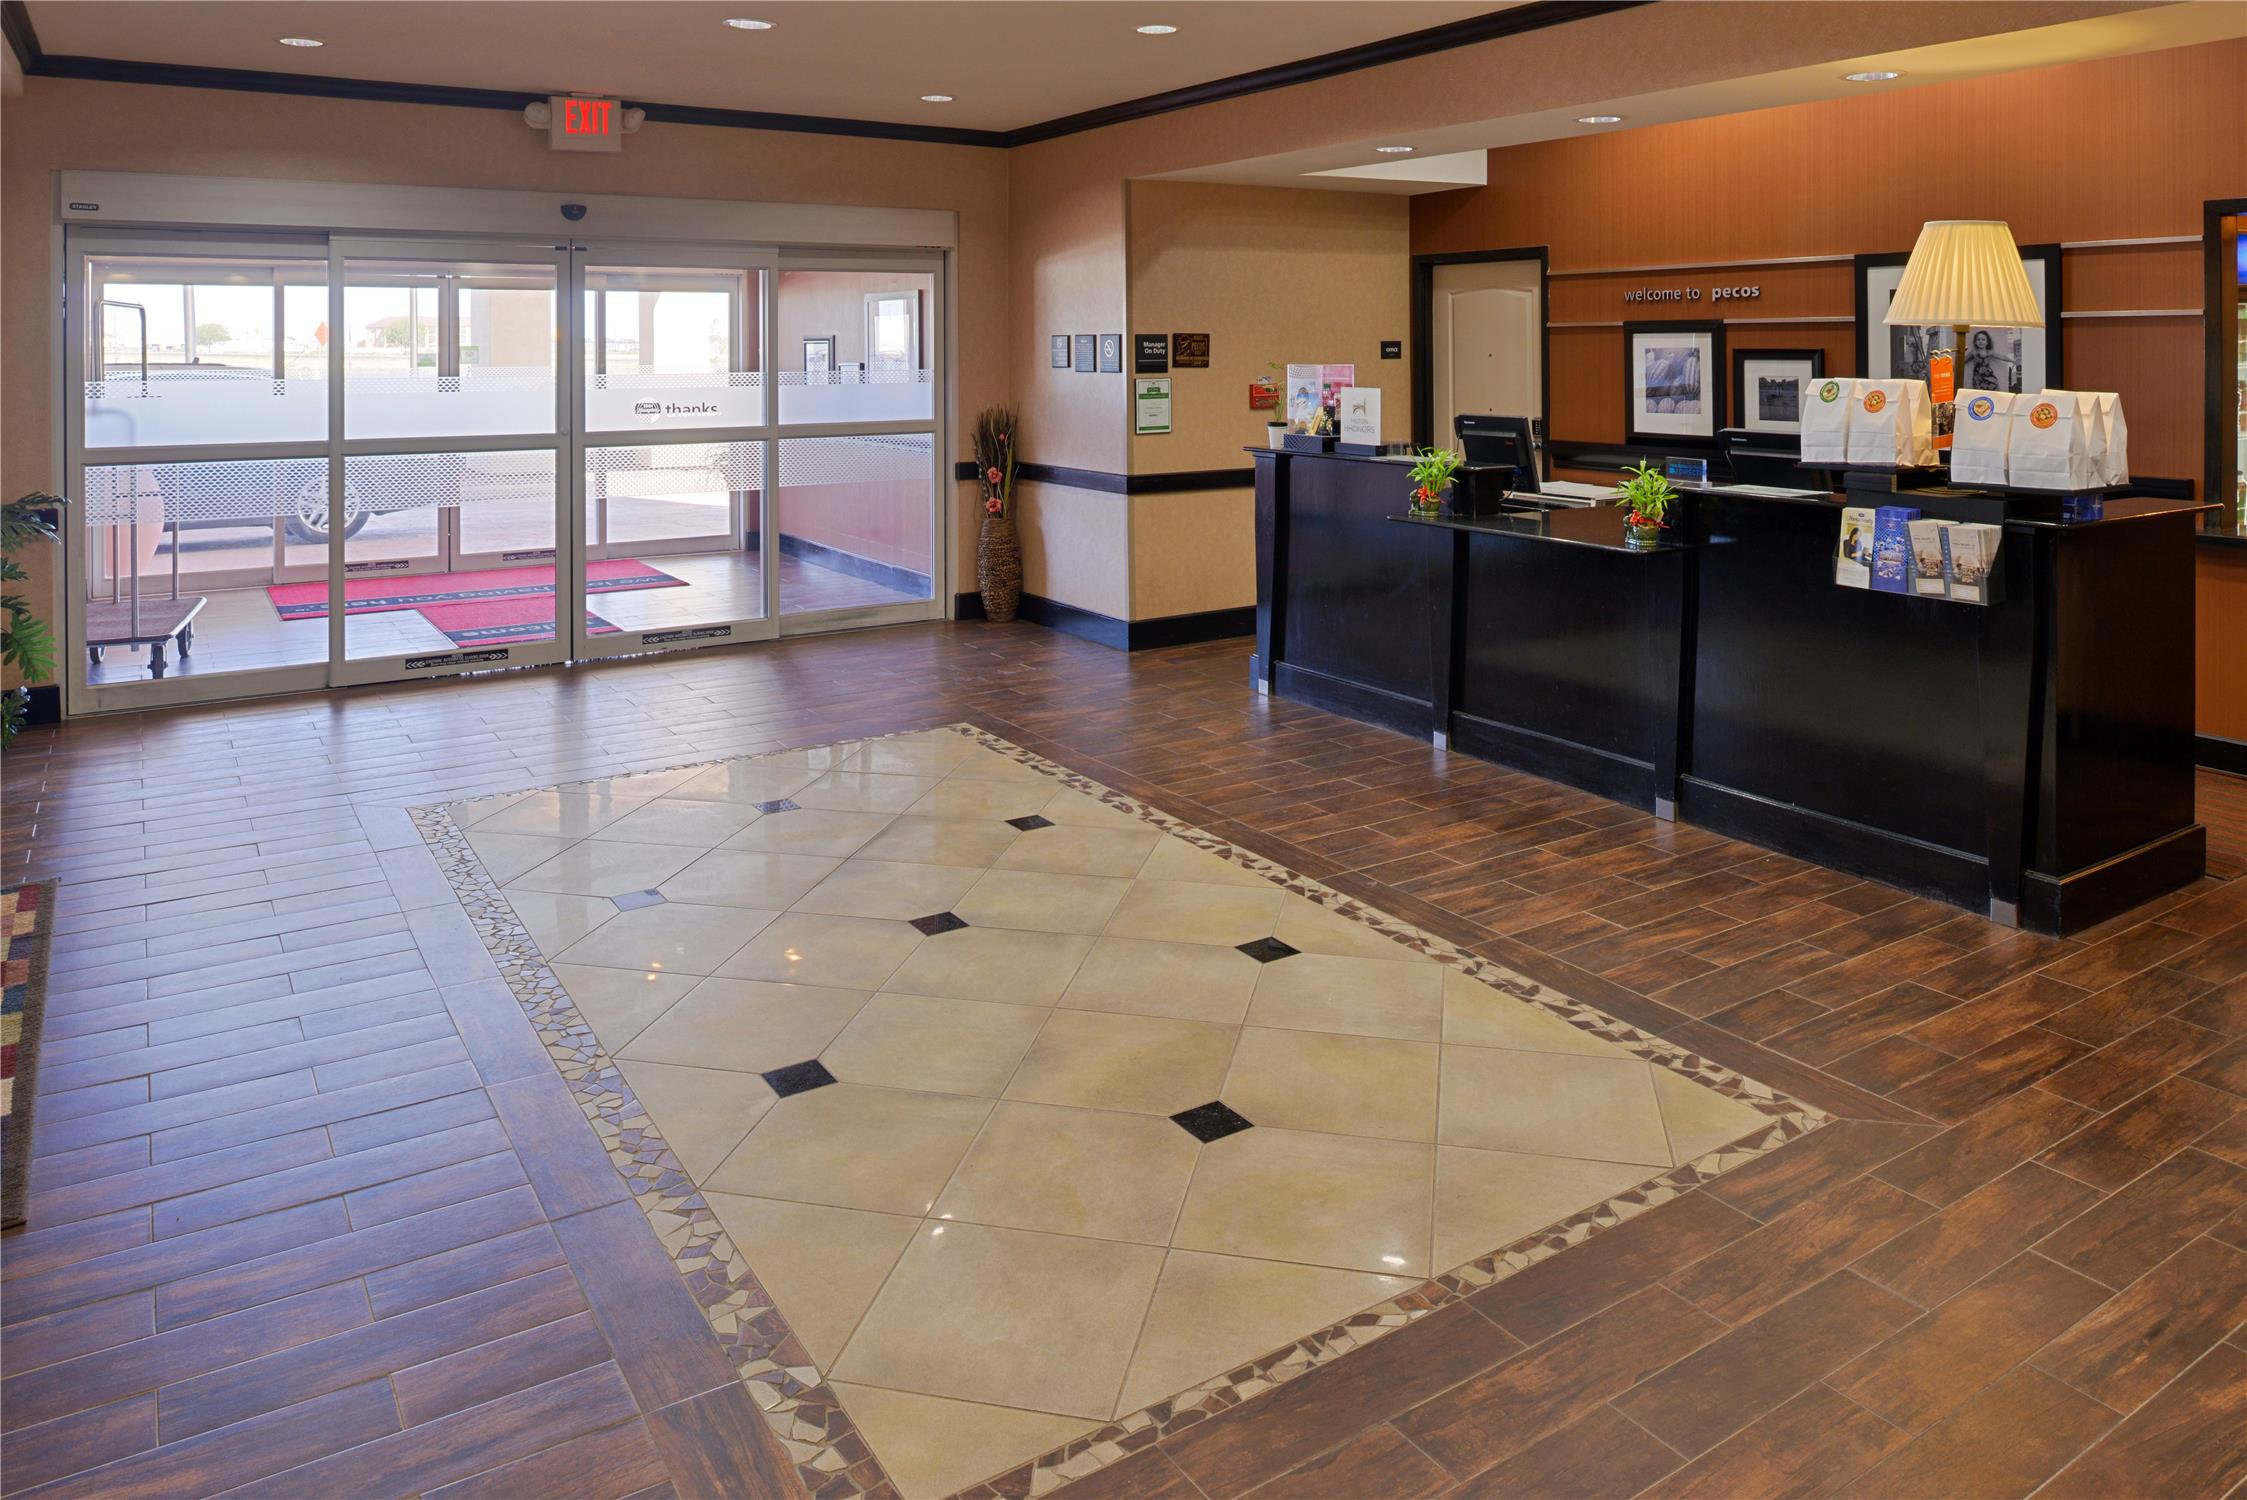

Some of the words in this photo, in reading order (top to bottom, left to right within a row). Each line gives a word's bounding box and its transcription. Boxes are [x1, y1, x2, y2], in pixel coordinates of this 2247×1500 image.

[565, 99, 613, 136] EXIT
[1624, 287, 1681, 301] welcome
[1686, 287, 1701, 299] to
[1711, 286, 1760, 302] pecos
[1143, 341, 1166, 349] Manager
